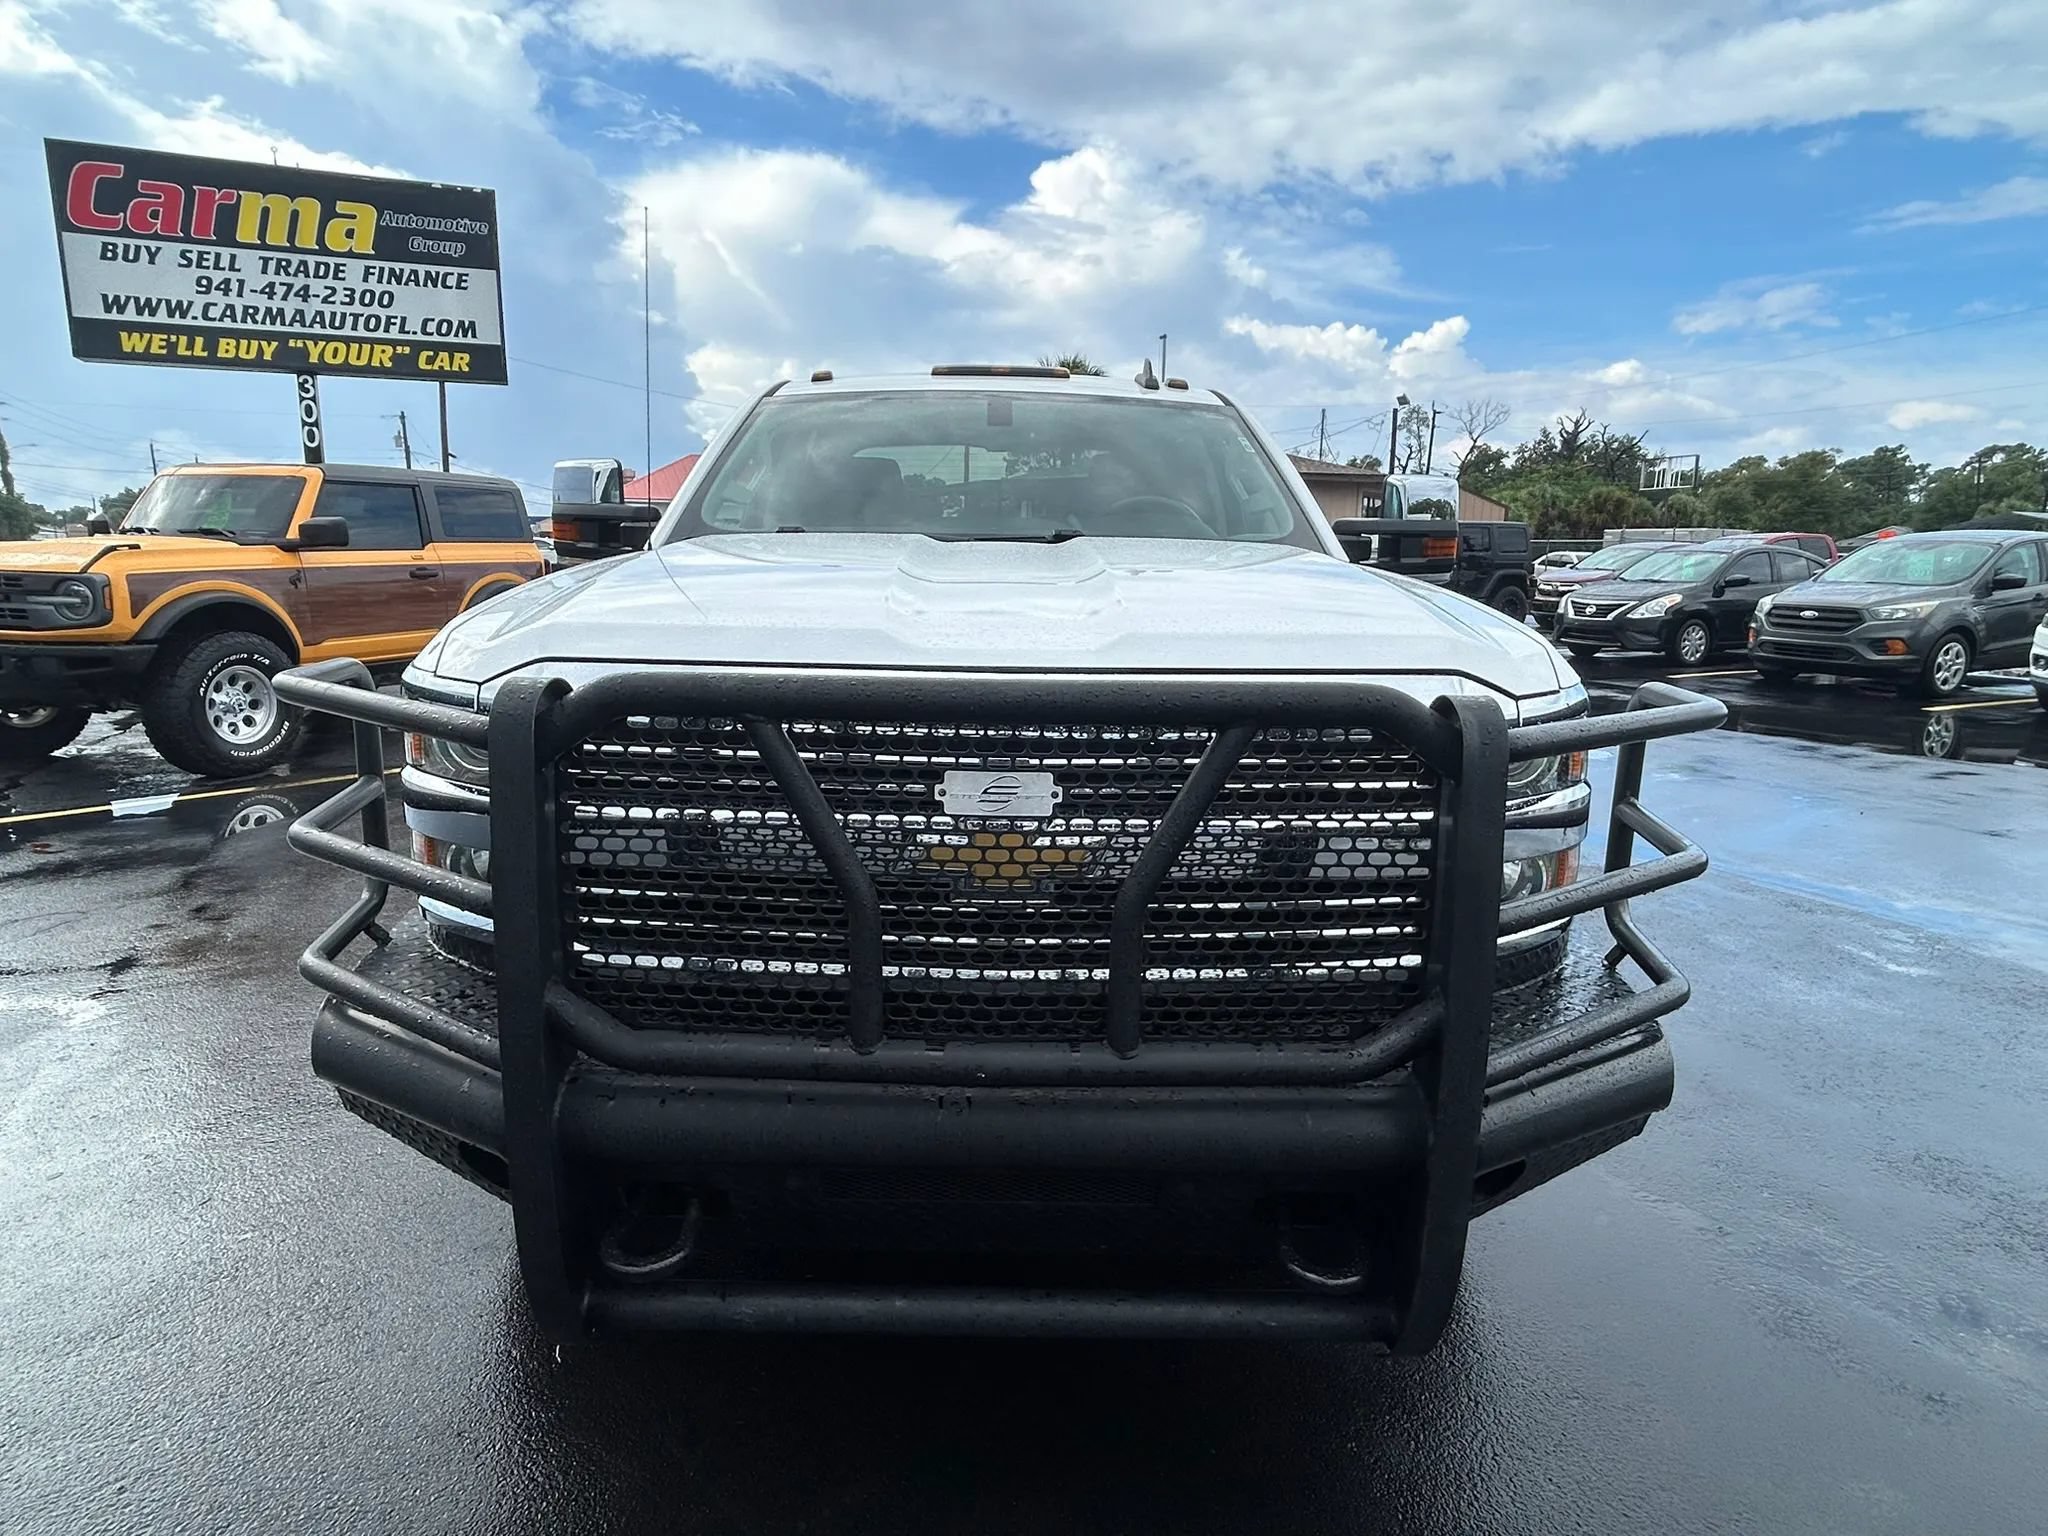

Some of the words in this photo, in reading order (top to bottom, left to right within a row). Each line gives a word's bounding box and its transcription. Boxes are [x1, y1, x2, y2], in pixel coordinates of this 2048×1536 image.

[66, 160, 376, 255] Carma
[380, 210, 489, 235] Automotive
[100, 241, 162, 265] BUY
[177, 249, 241, 272] SELL
[258, 255, 347, 281] TRADE
[362, 264, 470, 291] FINANCE
[408, 236, 466, 257] Group
[195, 275, 395, 309] 941-474-2300
[100, 292, 478, 339] WWW.CARMAAUTOFL.COM
[119, 331, 208, 357] WE'LL
[216, 337, 279, 360] BUY
[288, 339, 410, 368] "YOUR"
[418, 350, 470, 372] CAR
[298, 374, 320, 447] 300
